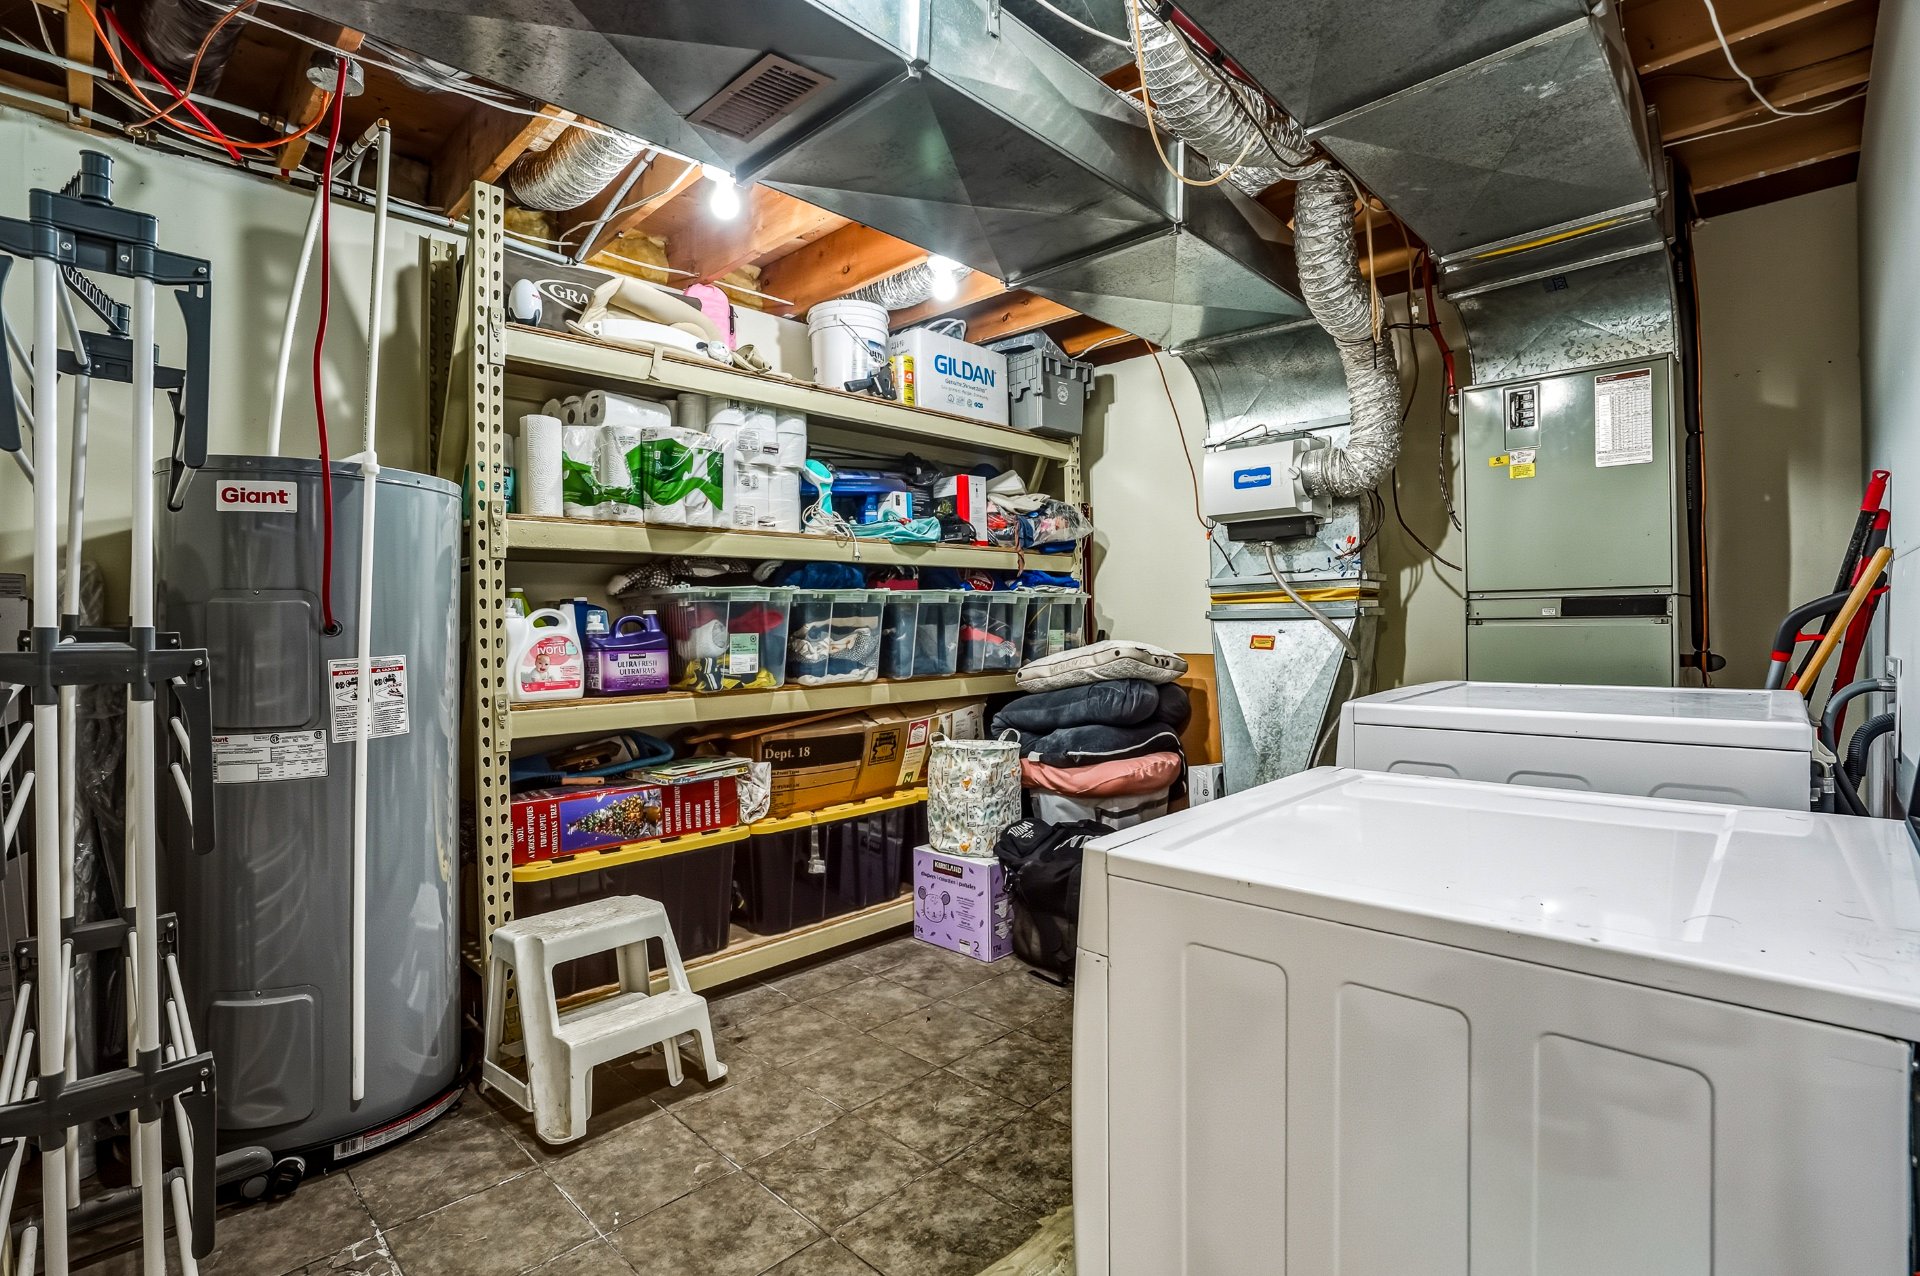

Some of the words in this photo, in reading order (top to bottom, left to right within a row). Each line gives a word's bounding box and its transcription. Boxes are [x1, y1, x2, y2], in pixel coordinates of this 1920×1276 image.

[549, 284, 588, 304] GRA
[934, 354, 995, 388] GILDAN
[220, 487, 289, 504] Giant
[536, 643, 566, 656] ivory
[617, 660, 638, 668] ULTRA
[764, 747, 794, 760] Dept.
[798, 746, 811, 757] 18
[539, 813, 547, 831] OPTIC
[934, 860, 963, 874] KIRKLAND
[973, 940, 980, 953] 2
